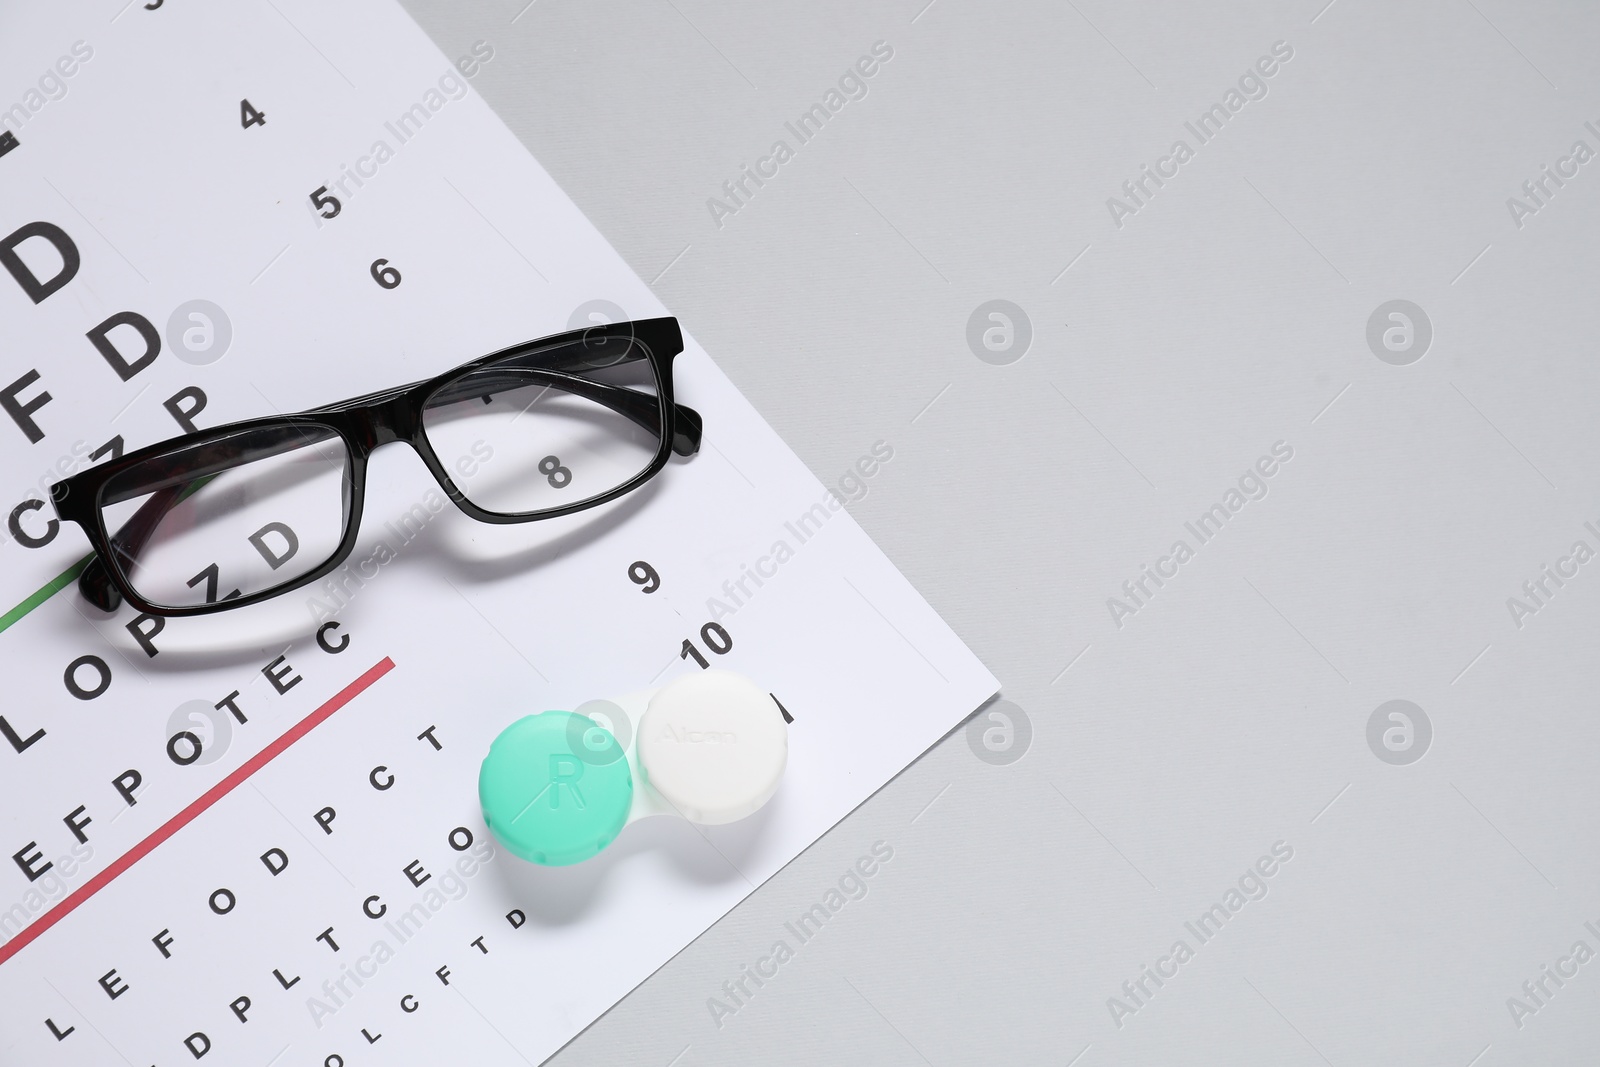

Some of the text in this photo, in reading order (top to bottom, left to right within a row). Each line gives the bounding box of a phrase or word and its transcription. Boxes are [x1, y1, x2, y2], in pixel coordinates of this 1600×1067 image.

[240, 98, 266, 130] 4
[309, 185, 342, 219] 5
[0, 221, 81, 305] D
[370, 258, 402, 290] 6
[0, 311, 162, 445] F D
[8, 386, 207, 548] C P
[538, 455, 573, 489] 8
[627, 560, 661, 594] 9
[0, 522, 299, 754] L O P Z D
[680, 621, 733, 670] 10
[12, 620, 351, 883] E F P O T E C
[549, 753, 586, 811] R
[44, 725, 443, 1042] L E F O D P C T
[183, 826, 474, 1060] D P L T C E O
[360, 1028, 382, 1045] L
[400, 994, 419, 1013] C
[435, 964, 451, 986] F
[470, 935, 489, 955] T
[505, 908, 527, 930] D
